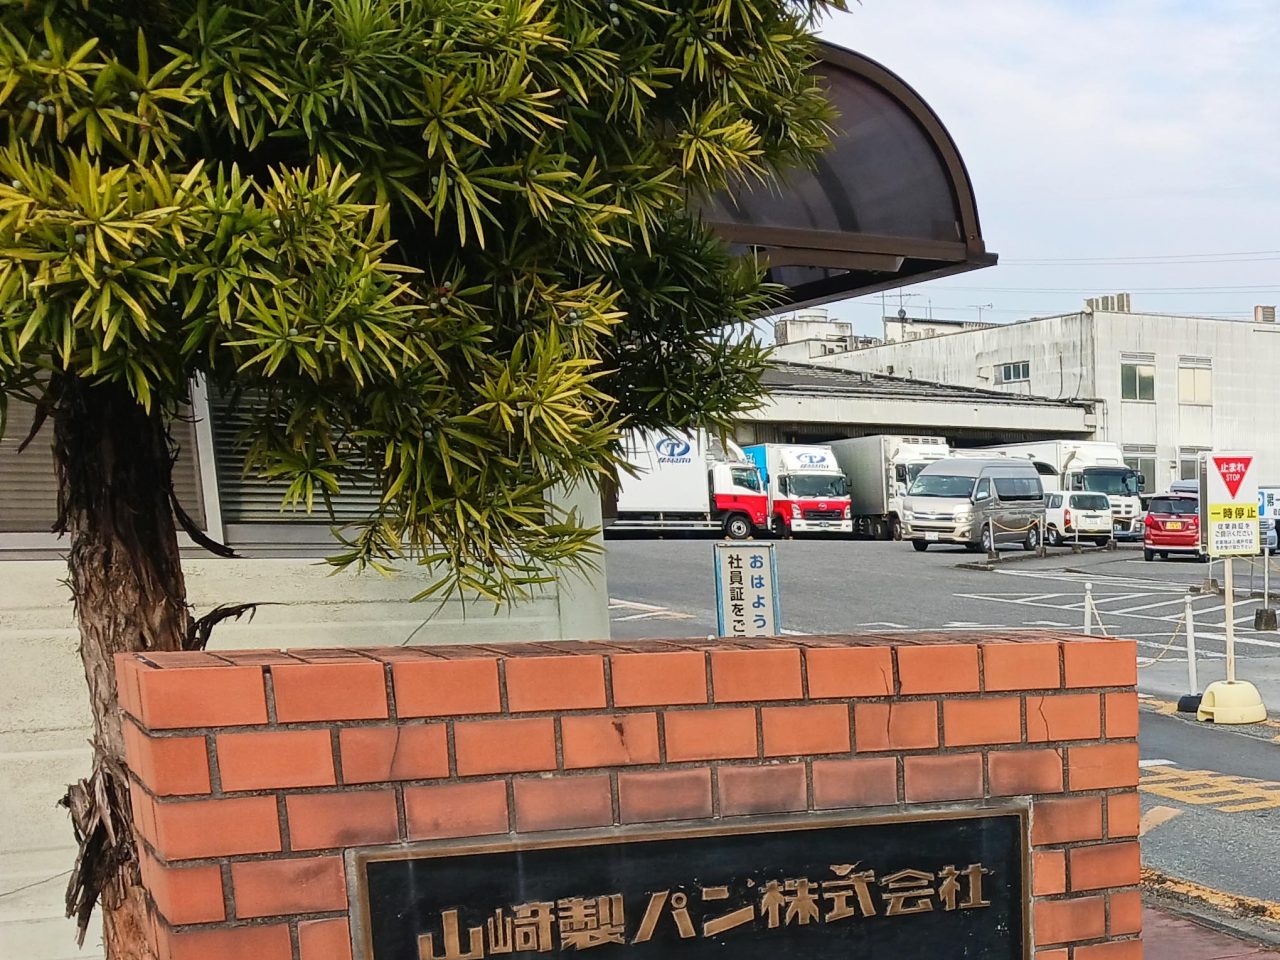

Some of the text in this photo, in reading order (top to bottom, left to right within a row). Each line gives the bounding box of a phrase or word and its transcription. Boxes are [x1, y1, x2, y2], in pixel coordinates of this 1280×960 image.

[1220, 462, 1245, 472] 止まれ
[1226, 473, 1240, 481] STOP
[1211, 507, 1257, 519] 一時停止
[727, 553, 746, 637] 社員証をご
[749, 553, 767, 637] おはよう
